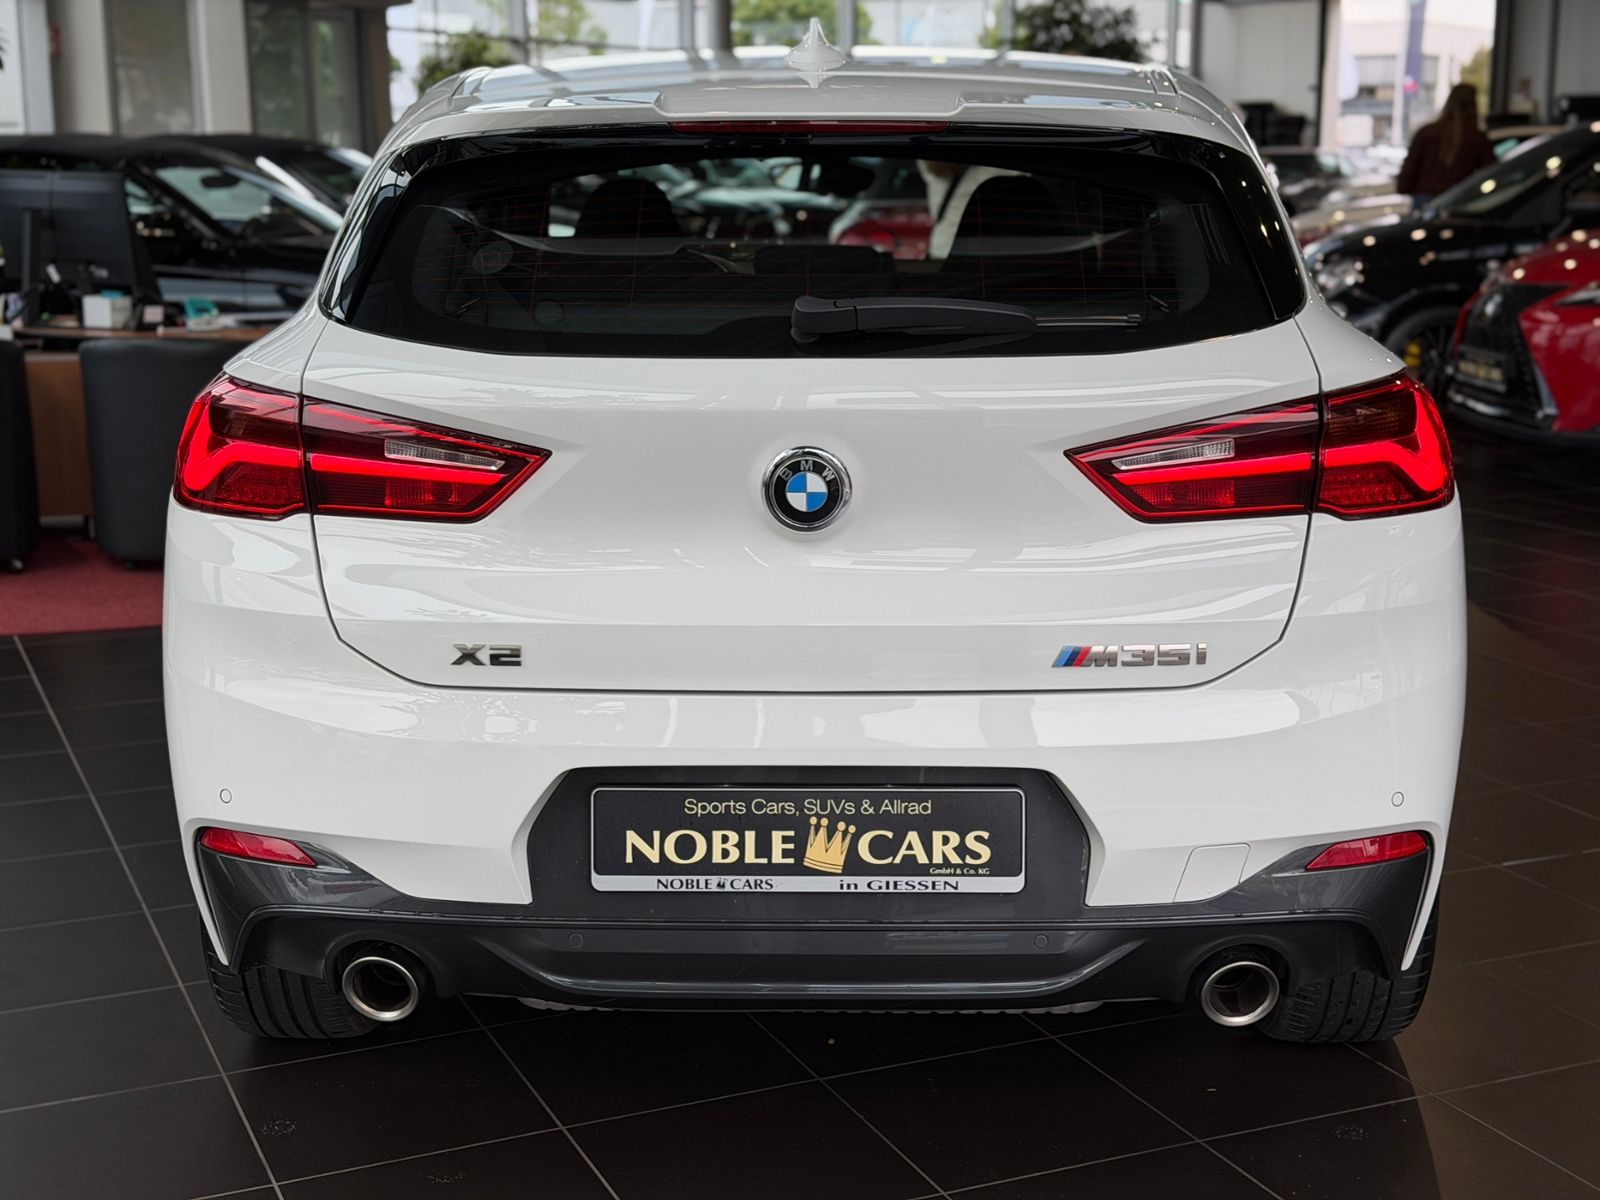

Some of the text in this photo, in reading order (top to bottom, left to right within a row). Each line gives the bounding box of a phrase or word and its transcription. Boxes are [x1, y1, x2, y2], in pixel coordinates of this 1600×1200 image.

[779, 460, 835, 481] BMW
[450, 643, 522, 667] X2
[1080, 642, 1208, 668] M35i
[684, 798, 932, 817] Sports Cars, SUVs & Allrad
[625, 830, 992, 865] NOBLE CARS
[929, 867, 990, 875] GmbH & Co. KG
[657, 879, 774, 890] NOBLE CARS
[839, 879, 960, 891] in GIESSEN
